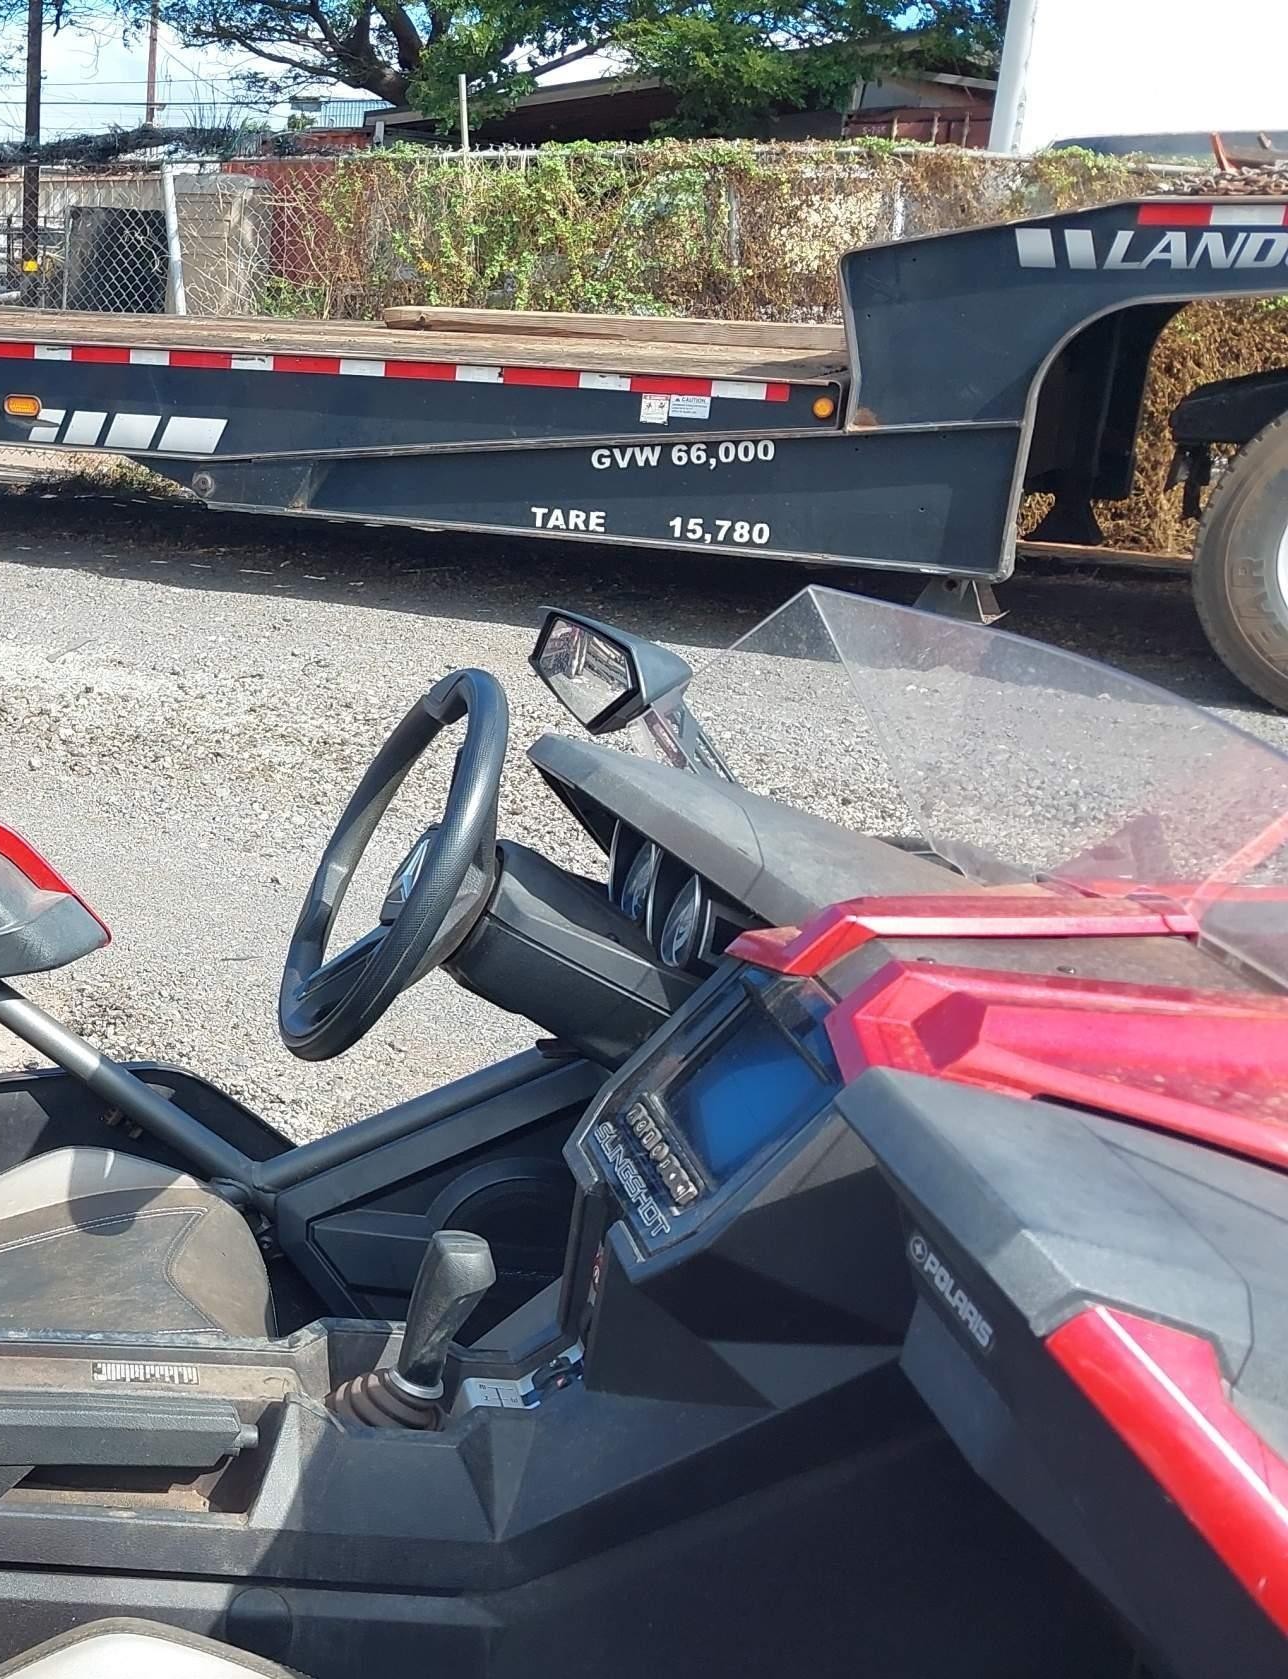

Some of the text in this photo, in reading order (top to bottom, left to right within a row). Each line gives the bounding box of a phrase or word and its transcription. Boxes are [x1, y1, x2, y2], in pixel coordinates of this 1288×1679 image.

[1102, 229, 1288, 270] LAND
[590, 439, 775, 470] GVW 66,000
[530, 507, 771, 545] TARE 15,780
[594, 1121, 671, 1237] SLINGSHOT
[924, 1252, 993, 1347] POLARIS
